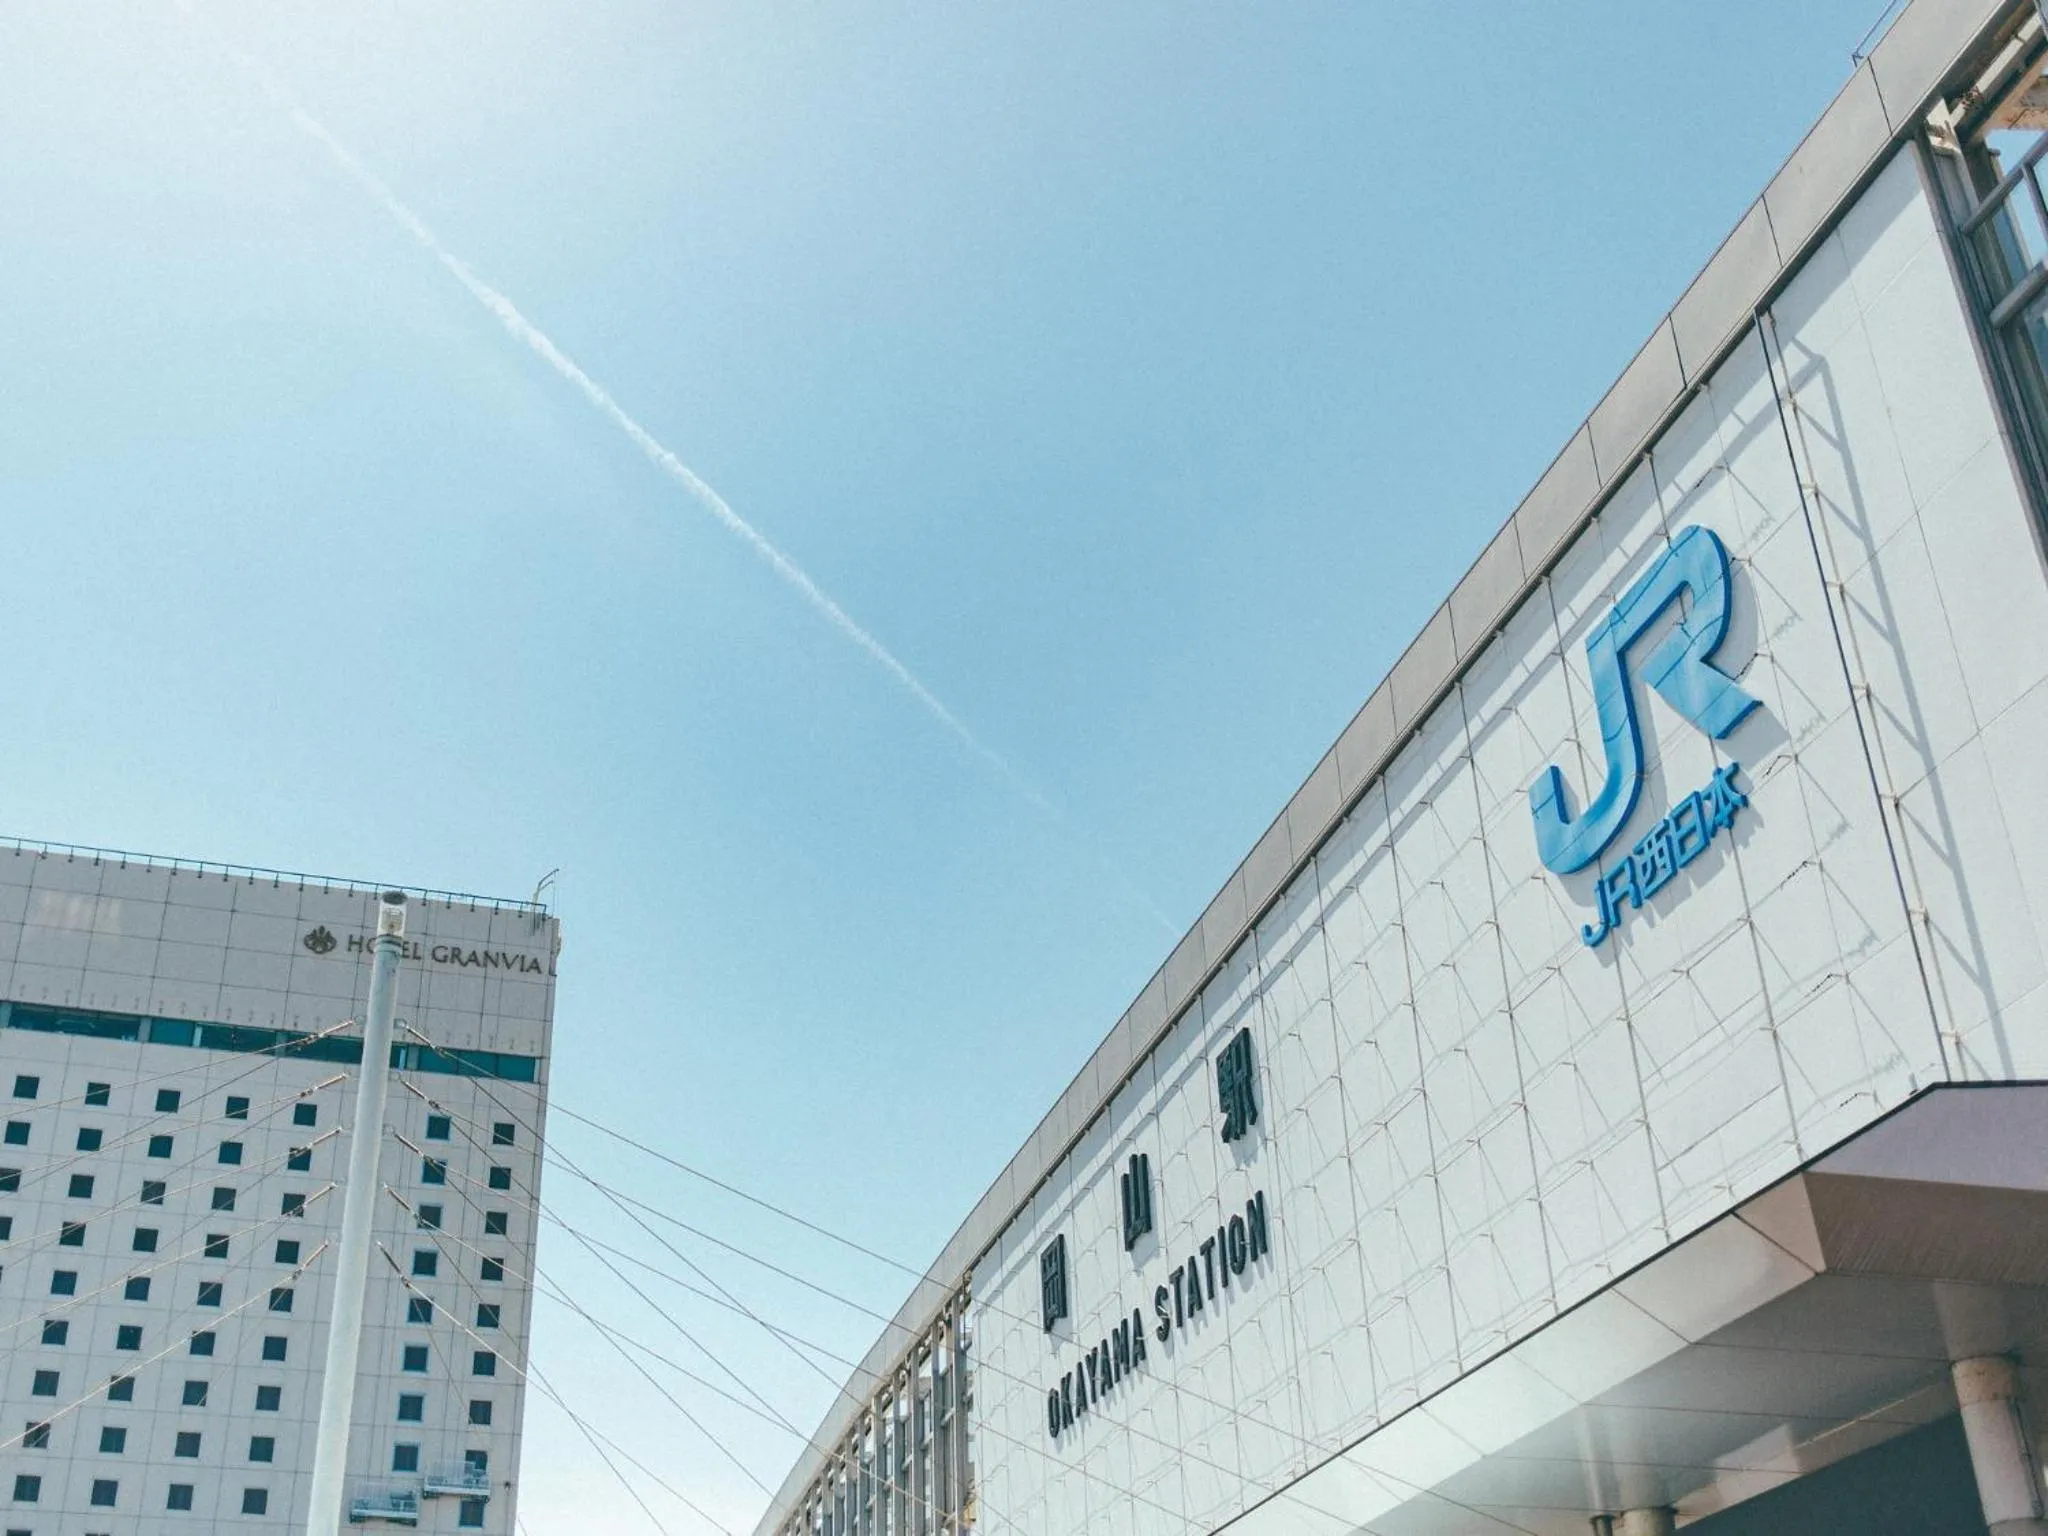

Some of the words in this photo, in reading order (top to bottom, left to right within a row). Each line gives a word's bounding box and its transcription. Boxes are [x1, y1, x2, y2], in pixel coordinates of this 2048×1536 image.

[1529, 524, 1763, 875] JR
[347, 934, 421, 960] HOEL
[431, 945, 542, 974] GRANVIA
[1582, 762, 1748, 948] JR西日本
[1048, 1307, 1147, 1438] OKAYAMA
[1154, 1190, 1268, 1342] STATION
